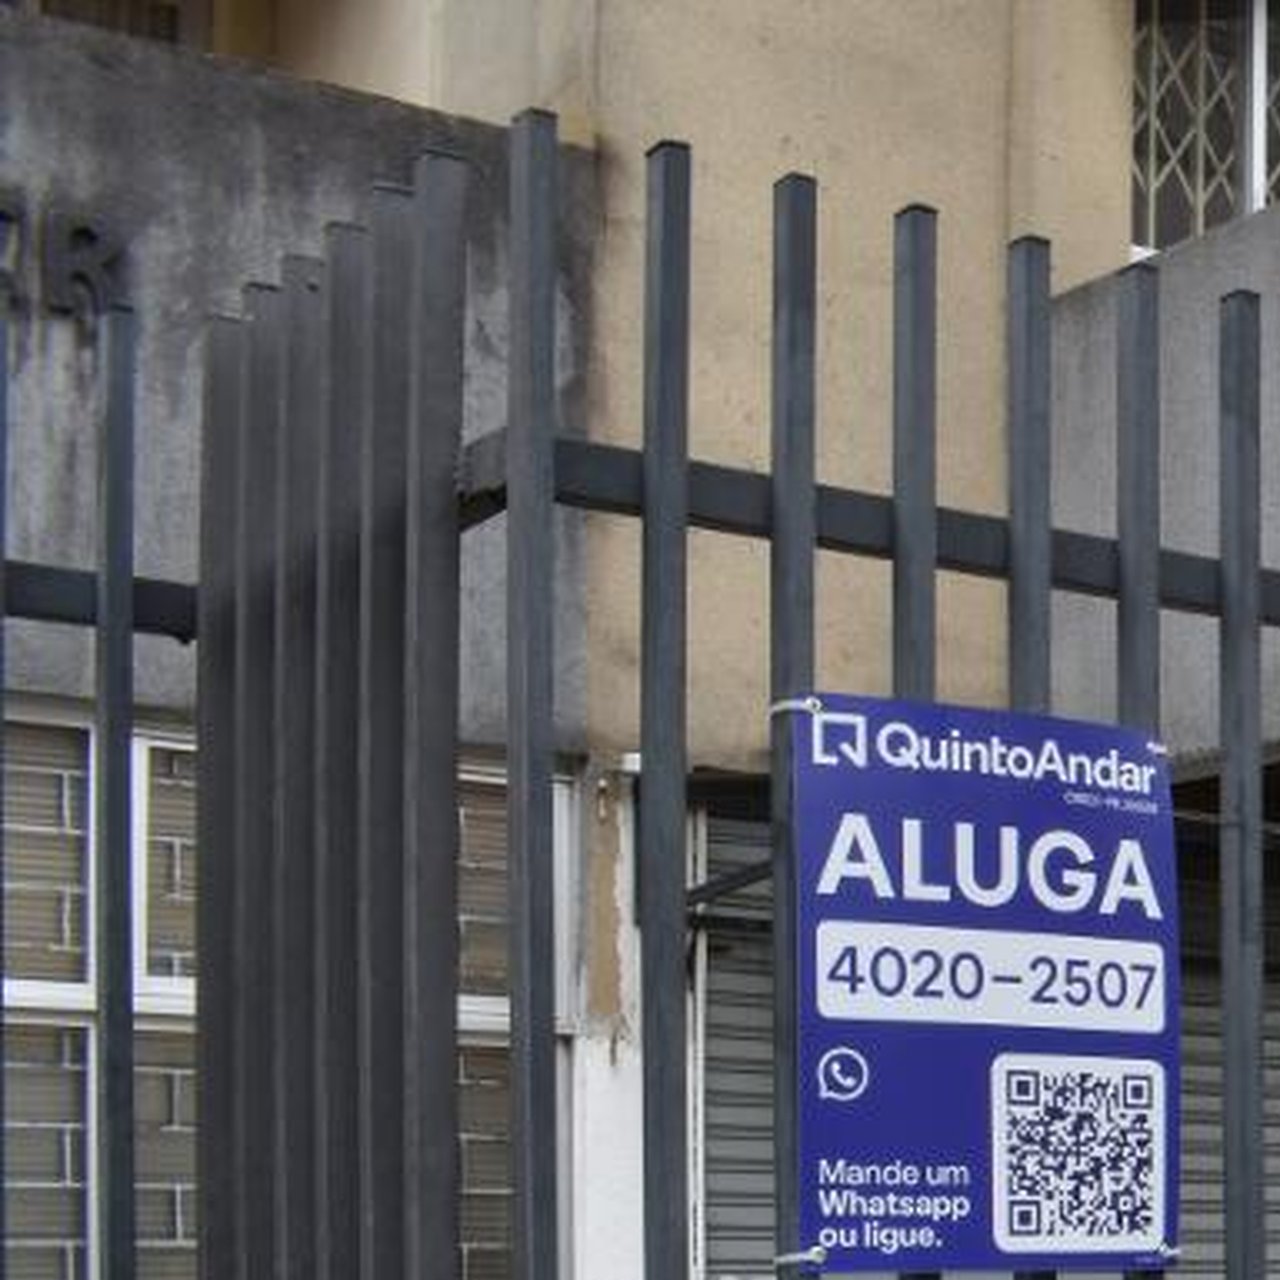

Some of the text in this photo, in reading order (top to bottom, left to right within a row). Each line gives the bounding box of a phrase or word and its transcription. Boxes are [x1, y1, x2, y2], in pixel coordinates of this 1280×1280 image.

[876, 722, 1157, 795] QuintoAndar
[816, 812, 1163, 920] ALUGA
[827, 945, 1157, 1010] 4020-2507
[818, 1159, 970, 1186] Mande um
[818, 1190, 970, 1220] Whatsapp
[818, 1221, 944, 1254] ou ligue.
